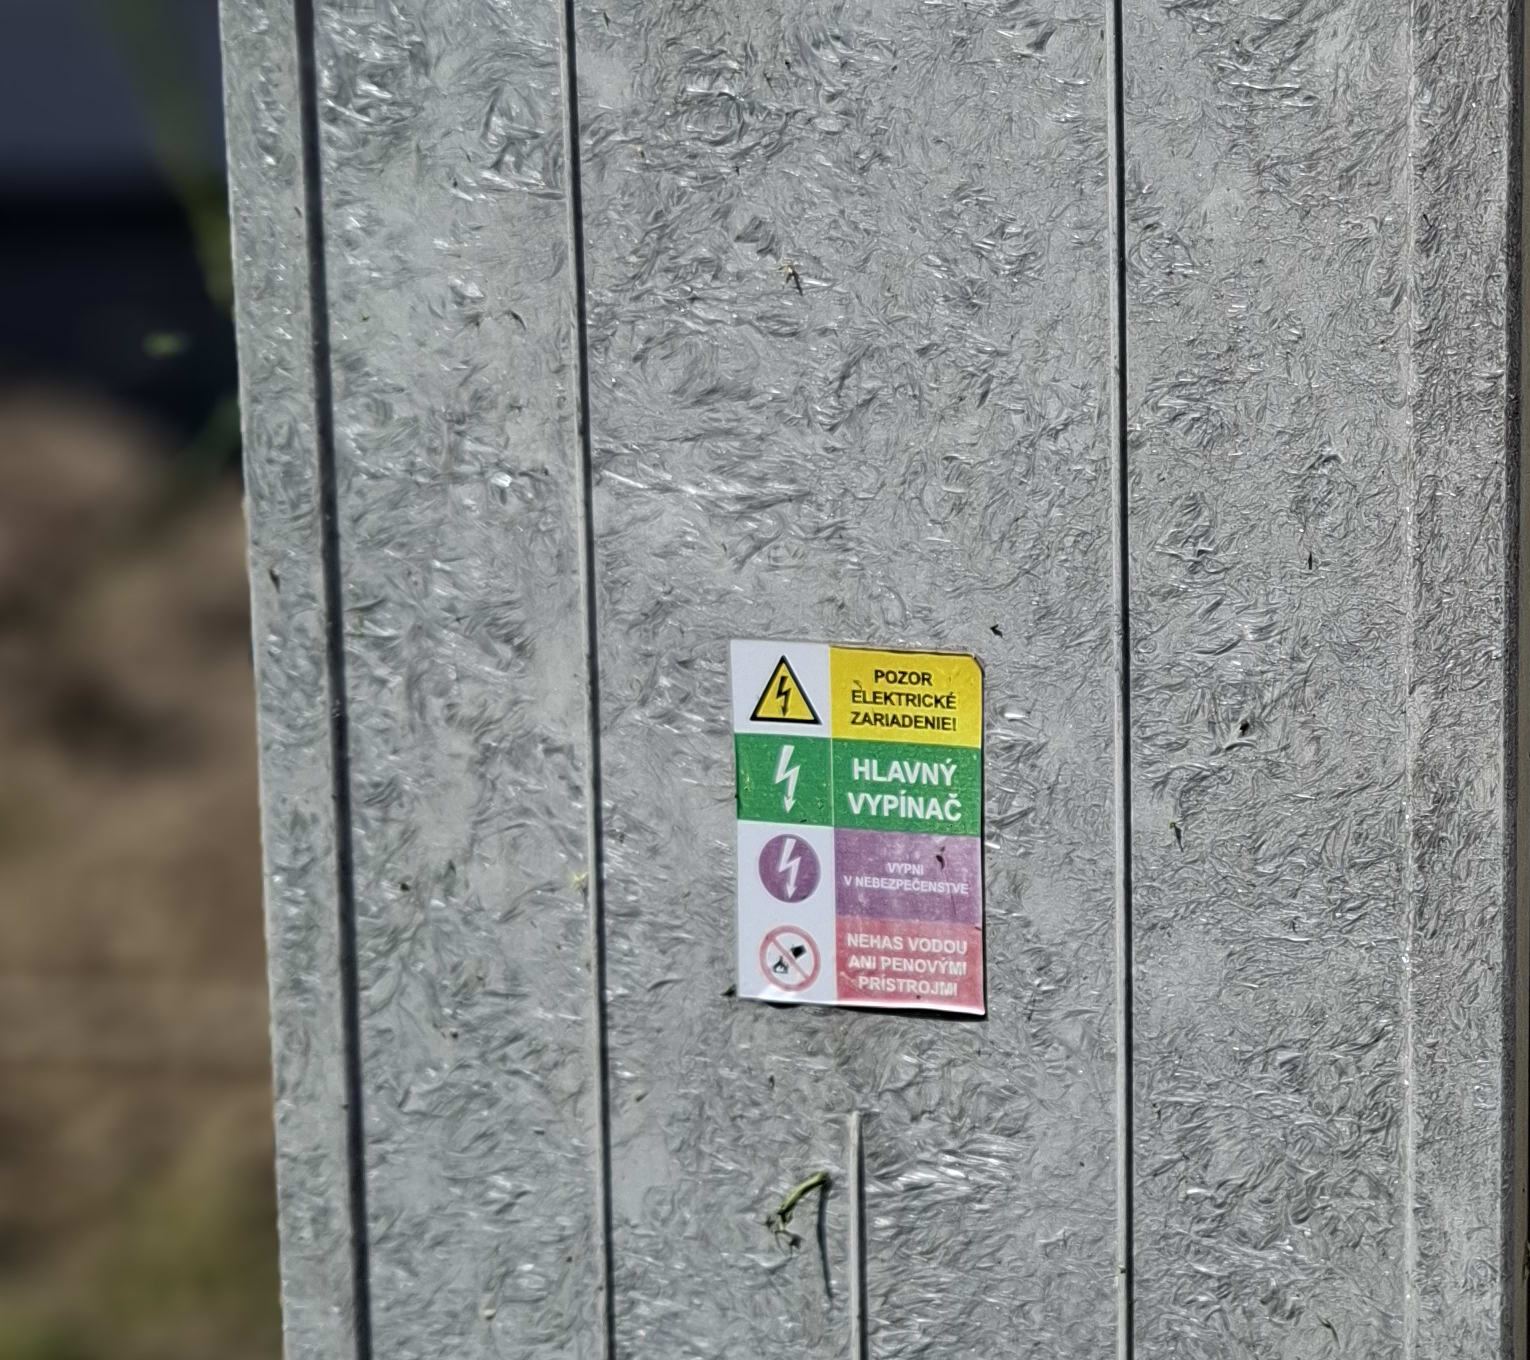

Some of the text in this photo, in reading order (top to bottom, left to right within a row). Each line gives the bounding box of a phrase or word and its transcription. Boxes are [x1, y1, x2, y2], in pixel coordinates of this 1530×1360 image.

[874, 669, 932, 686] POZOR
[852, 690, 956, 710] ELEKTRICKÉ
[851, 711, 957, 731] ZARIADENIE!
[853, 758, 957, 786] HLAVNÝ
[848, 790, 962, 822] VYPÍNAČ
[887, 862, 924, 876] VYPNI
[843, 875, 969, 895] V NEBEZPEČENSTVE
[847, 933, 968, 955] NEHAS VODOU
[848, 954, 967, 976] ANI PENOVÝMI
[858, 974, 958, 996] PRÍSTROJMI
